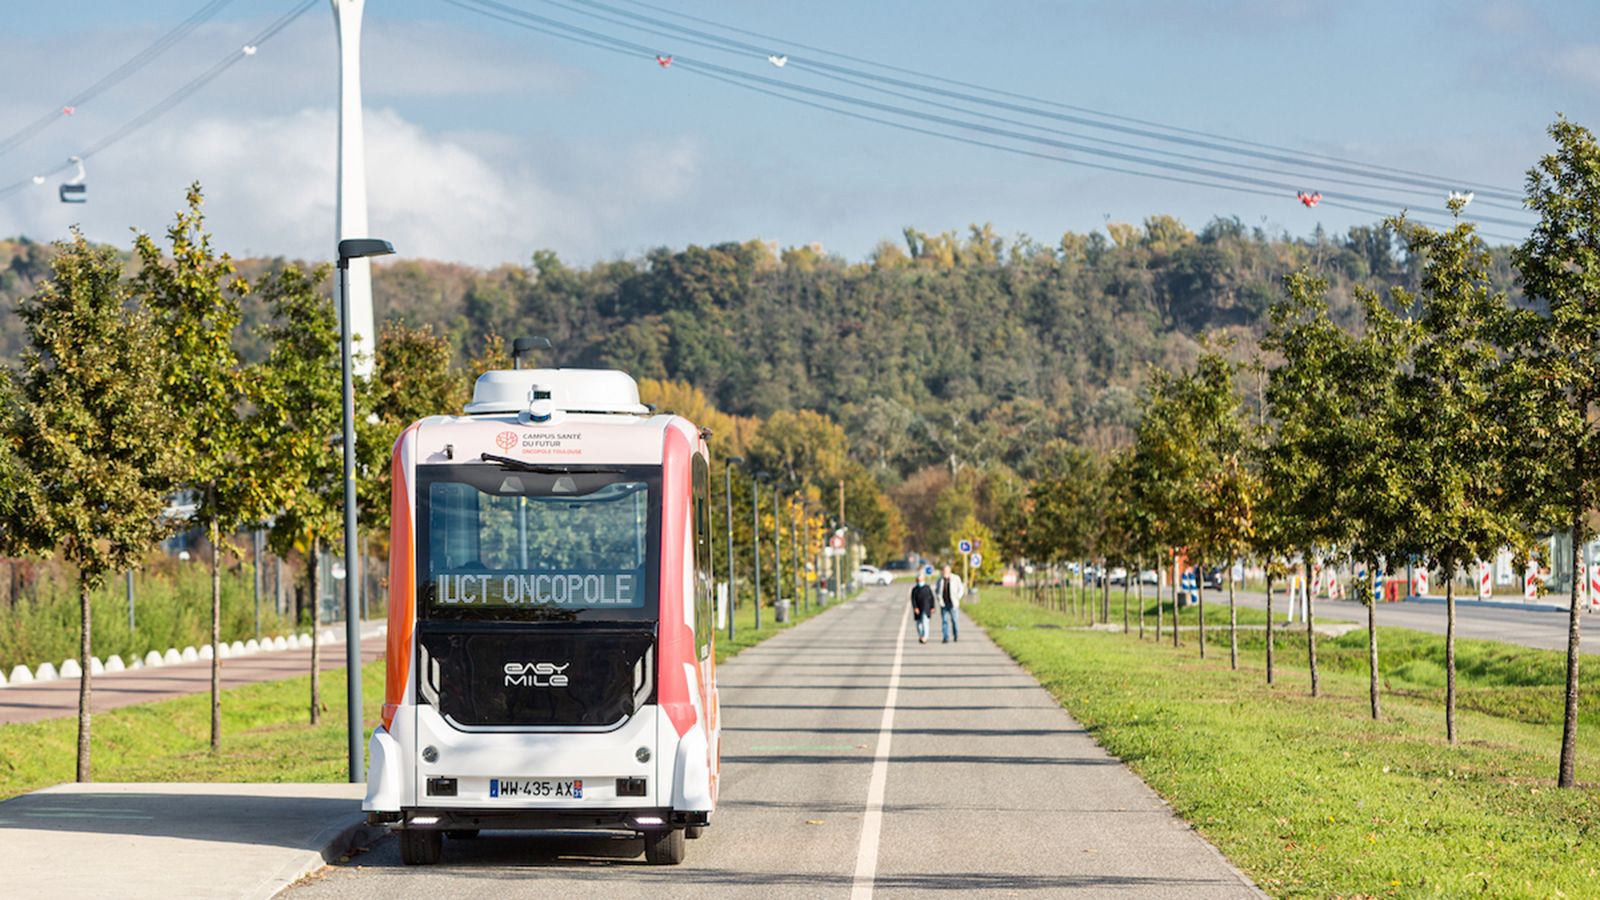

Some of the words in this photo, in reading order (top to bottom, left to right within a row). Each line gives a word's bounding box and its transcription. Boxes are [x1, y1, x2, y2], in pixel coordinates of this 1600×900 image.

[557, 432, 582, 440] SANTÉ
[438, 574, 492, 604] IUCT
[503, 574, 632, 604] ONCOPOLE
